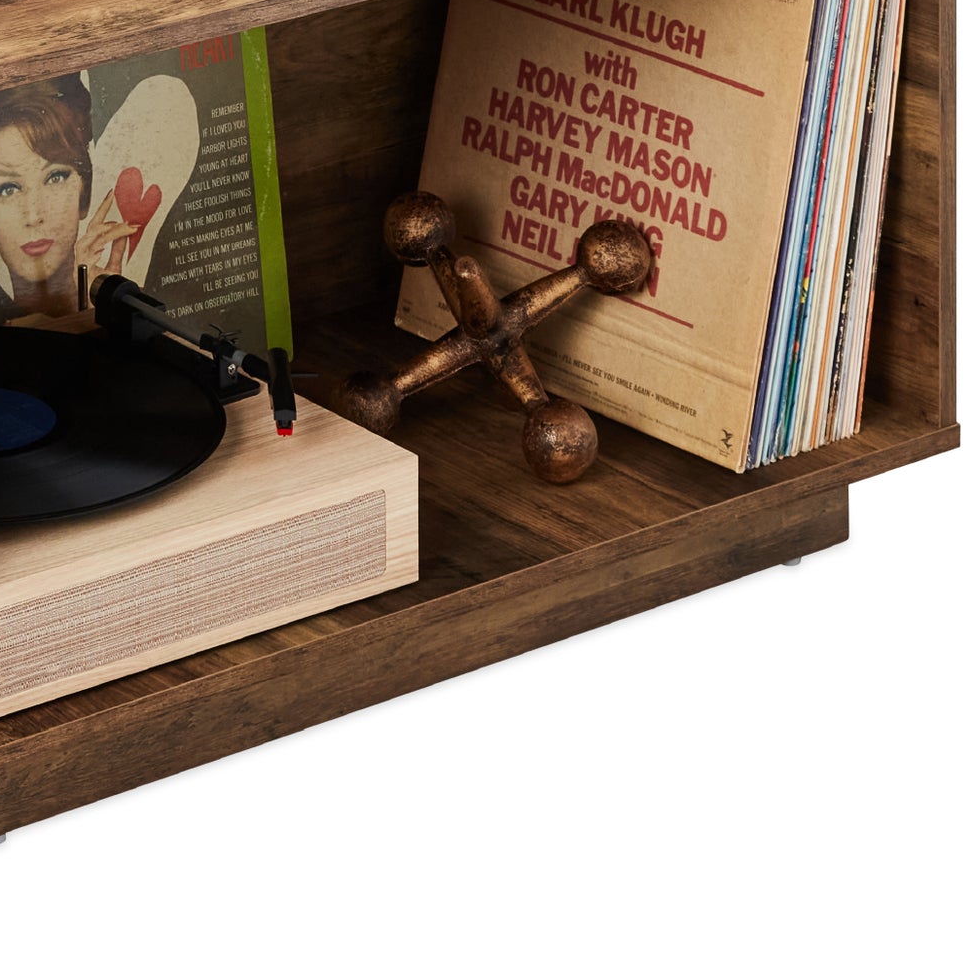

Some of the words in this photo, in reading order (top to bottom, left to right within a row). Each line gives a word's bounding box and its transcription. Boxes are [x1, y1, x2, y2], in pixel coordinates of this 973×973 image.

[583, 50, 638, 90] with
[211, 103, 244, 119] REMEMBER
[516, 58, 577, 107] RON
[579, 82, 694, 151] CARTER
[202, 127, 209, 138] IF
[214, 122, 232, 135] LOVED
[233, 119, 246, 130] YOU
[487, 87, 603, 154] HARVEY
[605, 130, 713, 198] MASON
[201, 141, 226, 155] HARBOR
[227, 136, 247, 149] LIGHTS
[199, 163, 220, 174] YOUNG
[221, 159, 228, 168] AT
[230, 153, 248, 166] HEART
[189, 180, 210, 193] YOU'LL
[212, 175, 231, 188] NEVER
[232, 171, 249, 183] KNOW
[461, 115, 553, 177] RALPH
[555, 151, 727, 243] MacDONALD
[185, 199, 203, 211] THESE
[204, 193, 229, 207] FOOLISH
[230, 187, 251, 200] THINGS
[509, 175, 589, 229] GARY
[174, 221, 184, 233] I'M
[185, 220, 191, 229] IN
[194, 216, 204, 227] THE
[206, 211, 224, 224] MOOD
[225, 208, 237, 219] FOR
[238, 204, 252, 215] LOVE
[169, 241, 181, 250] MA,
[181, 237, 195, 247] HE'S
[197, 231, 219, 244] MAKING
[221, 226, 235, 237] EYES
[236, 223, 243, 233] AT
[245, 221, 253, 231] ME
[501, 209, 563, 261] NEIL
[175, 255, 186, 265] I'LL
[187, 251, 198, 262] SEE
[200, 247, 212, 259] YOU
[213, 245, 219, 255] IN
[221, 244, 230, 254] MY
[231, 237, 256, 251] DREAMS
[161, 271, 188, 286] DANCING
[188, 266, 203, 279] WITH
[205, 262, 223, 275] TEARS
[225, 258, 231, 268] IN
[232, 256, 242, 267] MY
[243, 252, 257, 265] EYES
[203, 282, 214, 293] I'LL
[215, 279, 223, 289] BE
[225, 273, 246, 287] SEEING
[247, 269, 259, 280] YOU
[177, 305, 194, 317] DARK
[195, 302, 204, 312] ON
[205, 291, 245, 309] OBSERVATORY
[247, 287, 259, 297] HILL
[573, 359, 591, 373] NEVER
[592, 367, 602, 377] SEE
[603, 372, 615, 383] YOU
[616, 377, 632, 390] SMILE
[633, 384, 651, 397] AGAIN
[655, 393, 680, 409] WINDING
[680, 403, 697, 417] RIVER
